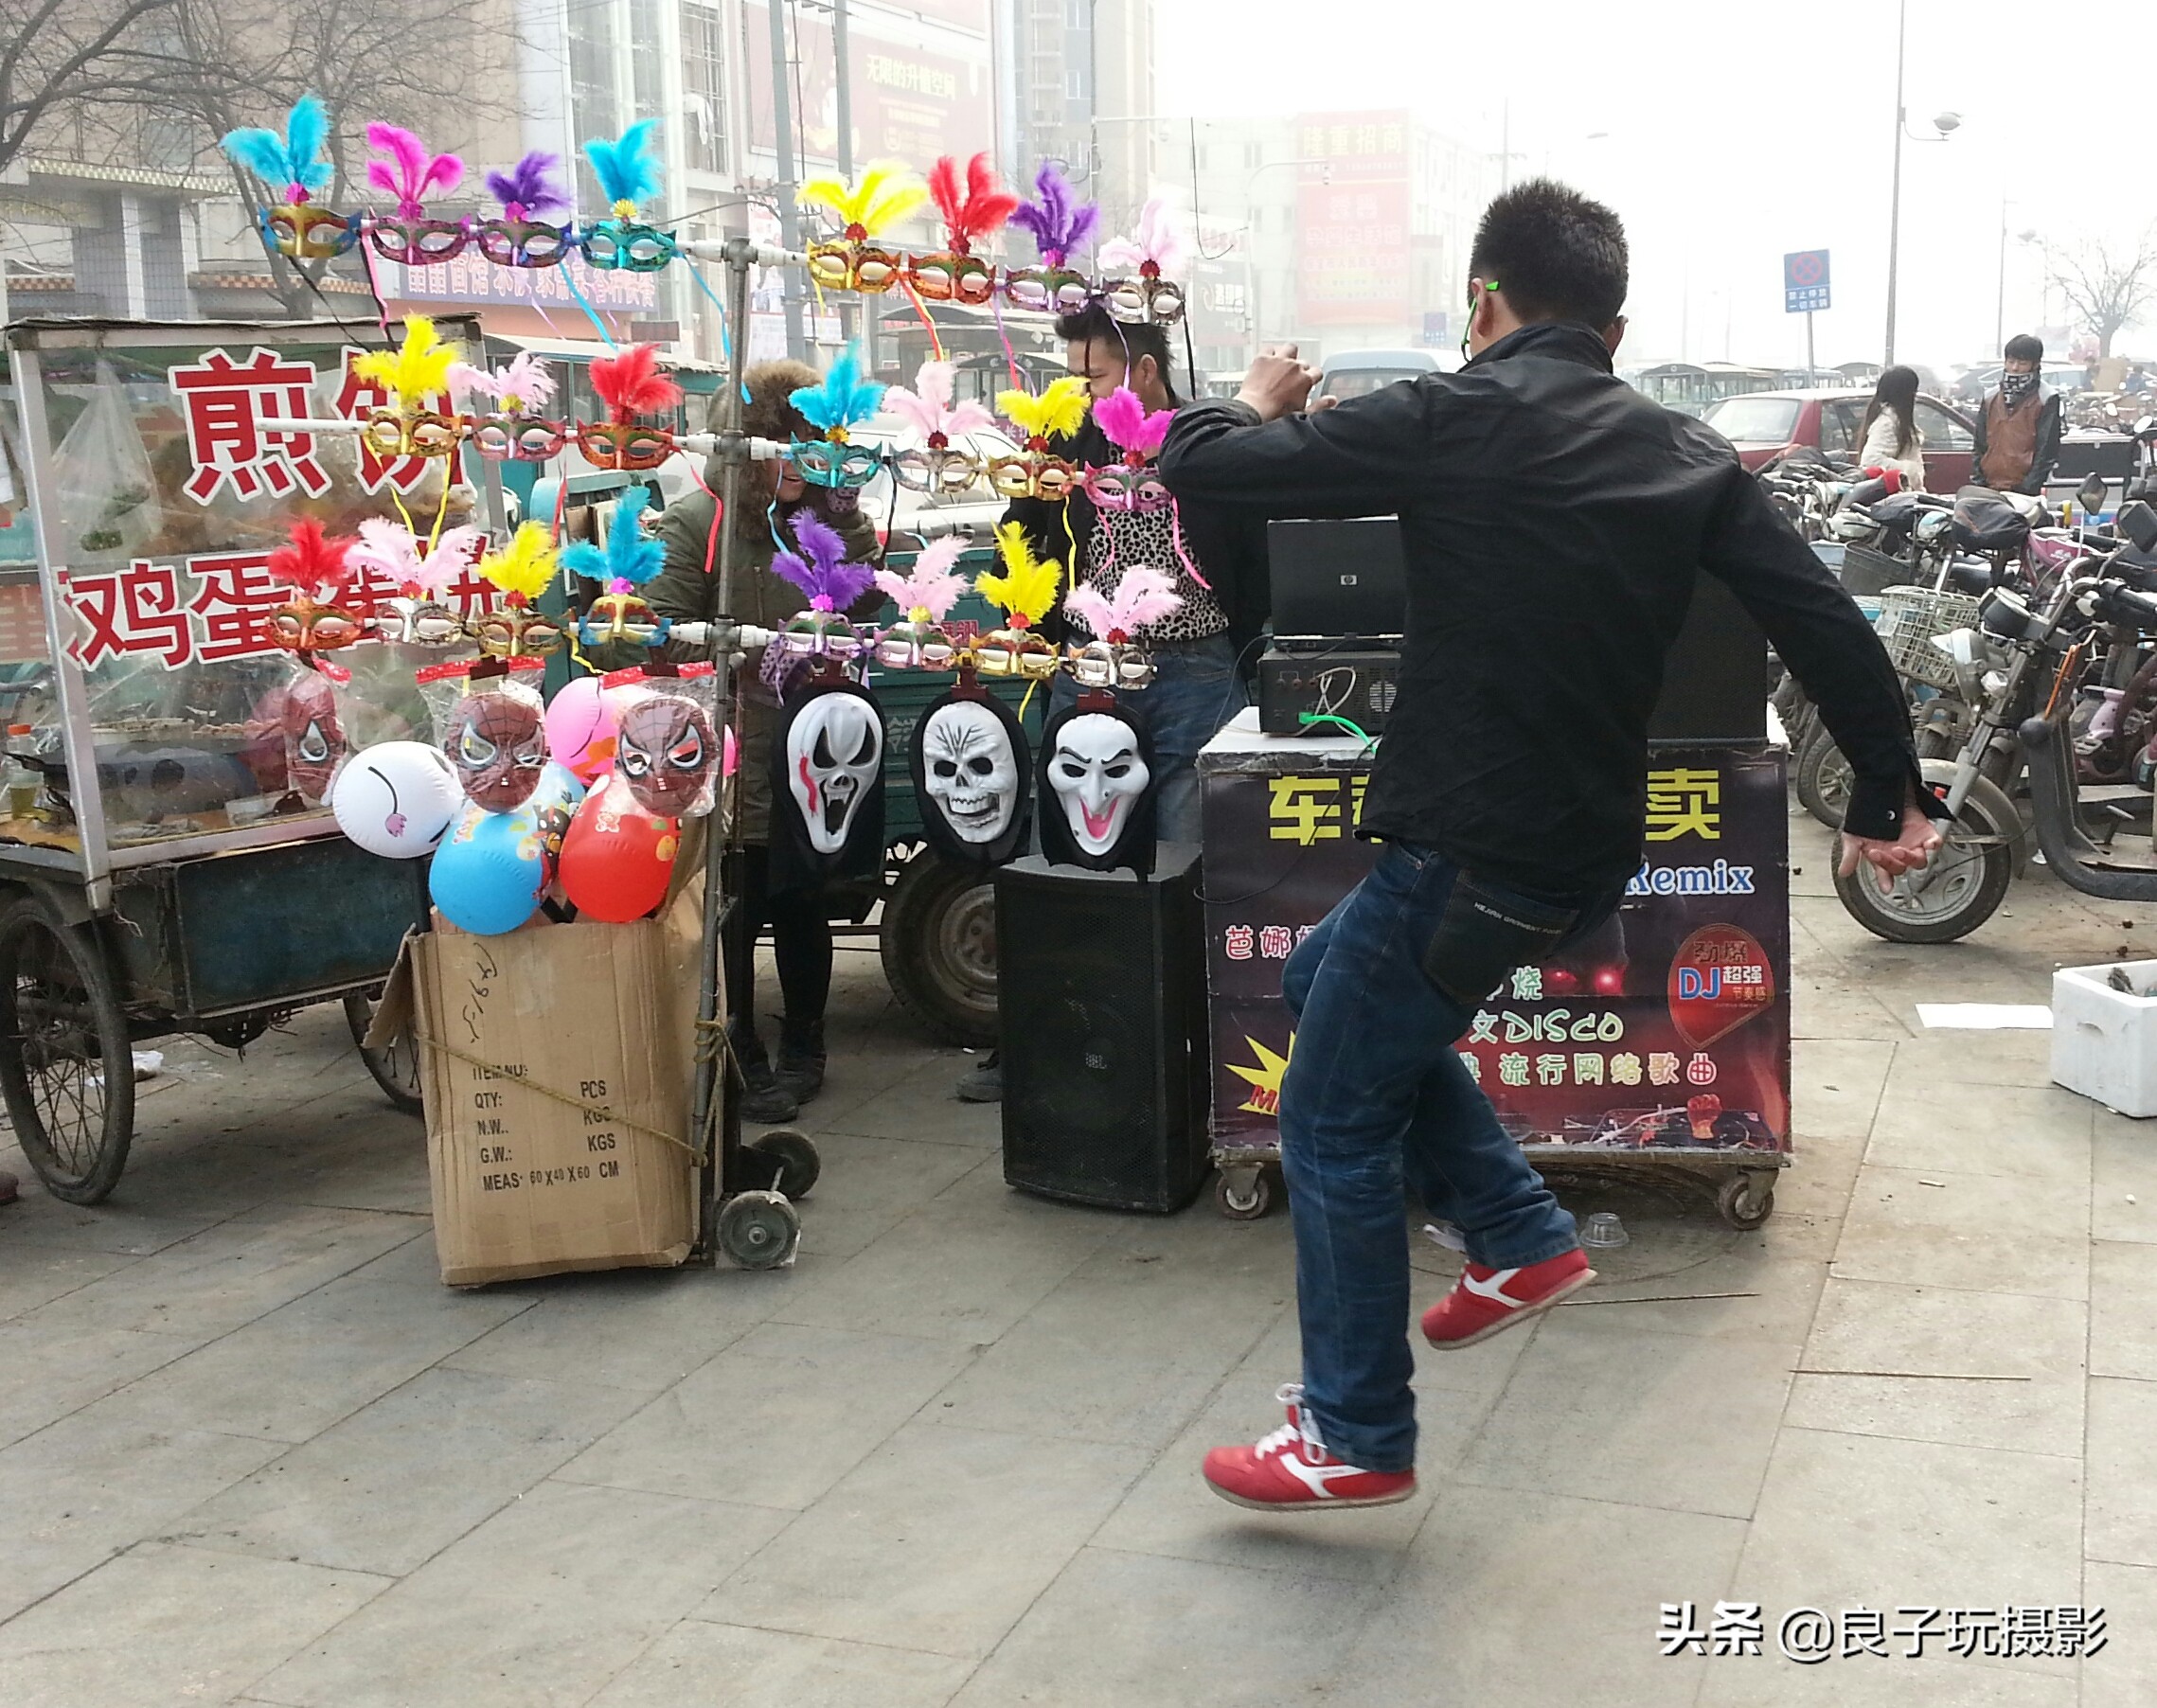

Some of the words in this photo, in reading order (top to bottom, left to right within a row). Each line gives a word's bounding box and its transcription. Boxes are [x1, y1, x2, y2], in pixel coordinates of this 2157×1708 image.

[866, 53, 955, 100] 无限的升值空间
[1304, 122, 1401, 157] 隆重招商
[1646, 768, 1720, 841] 卖
[1226, 925, 1317, 959] 芭娜
[1679, 967, 1720, 1000] DJ
[1723, 966, 1762, 984] 超强
[1732, 987, 1767, 1001] 节奏感
[1499, 1051, 1718, 1086] 流行网络歌曲
[474, 1092, 503, 1109] QTY:
[580, 1080, 607, 1099] PCS
[480, 1147, 512, 1164] G.W.:
[588, 1132, 615, 1152] KGS
[599, 1160, 619, 1178] CM
